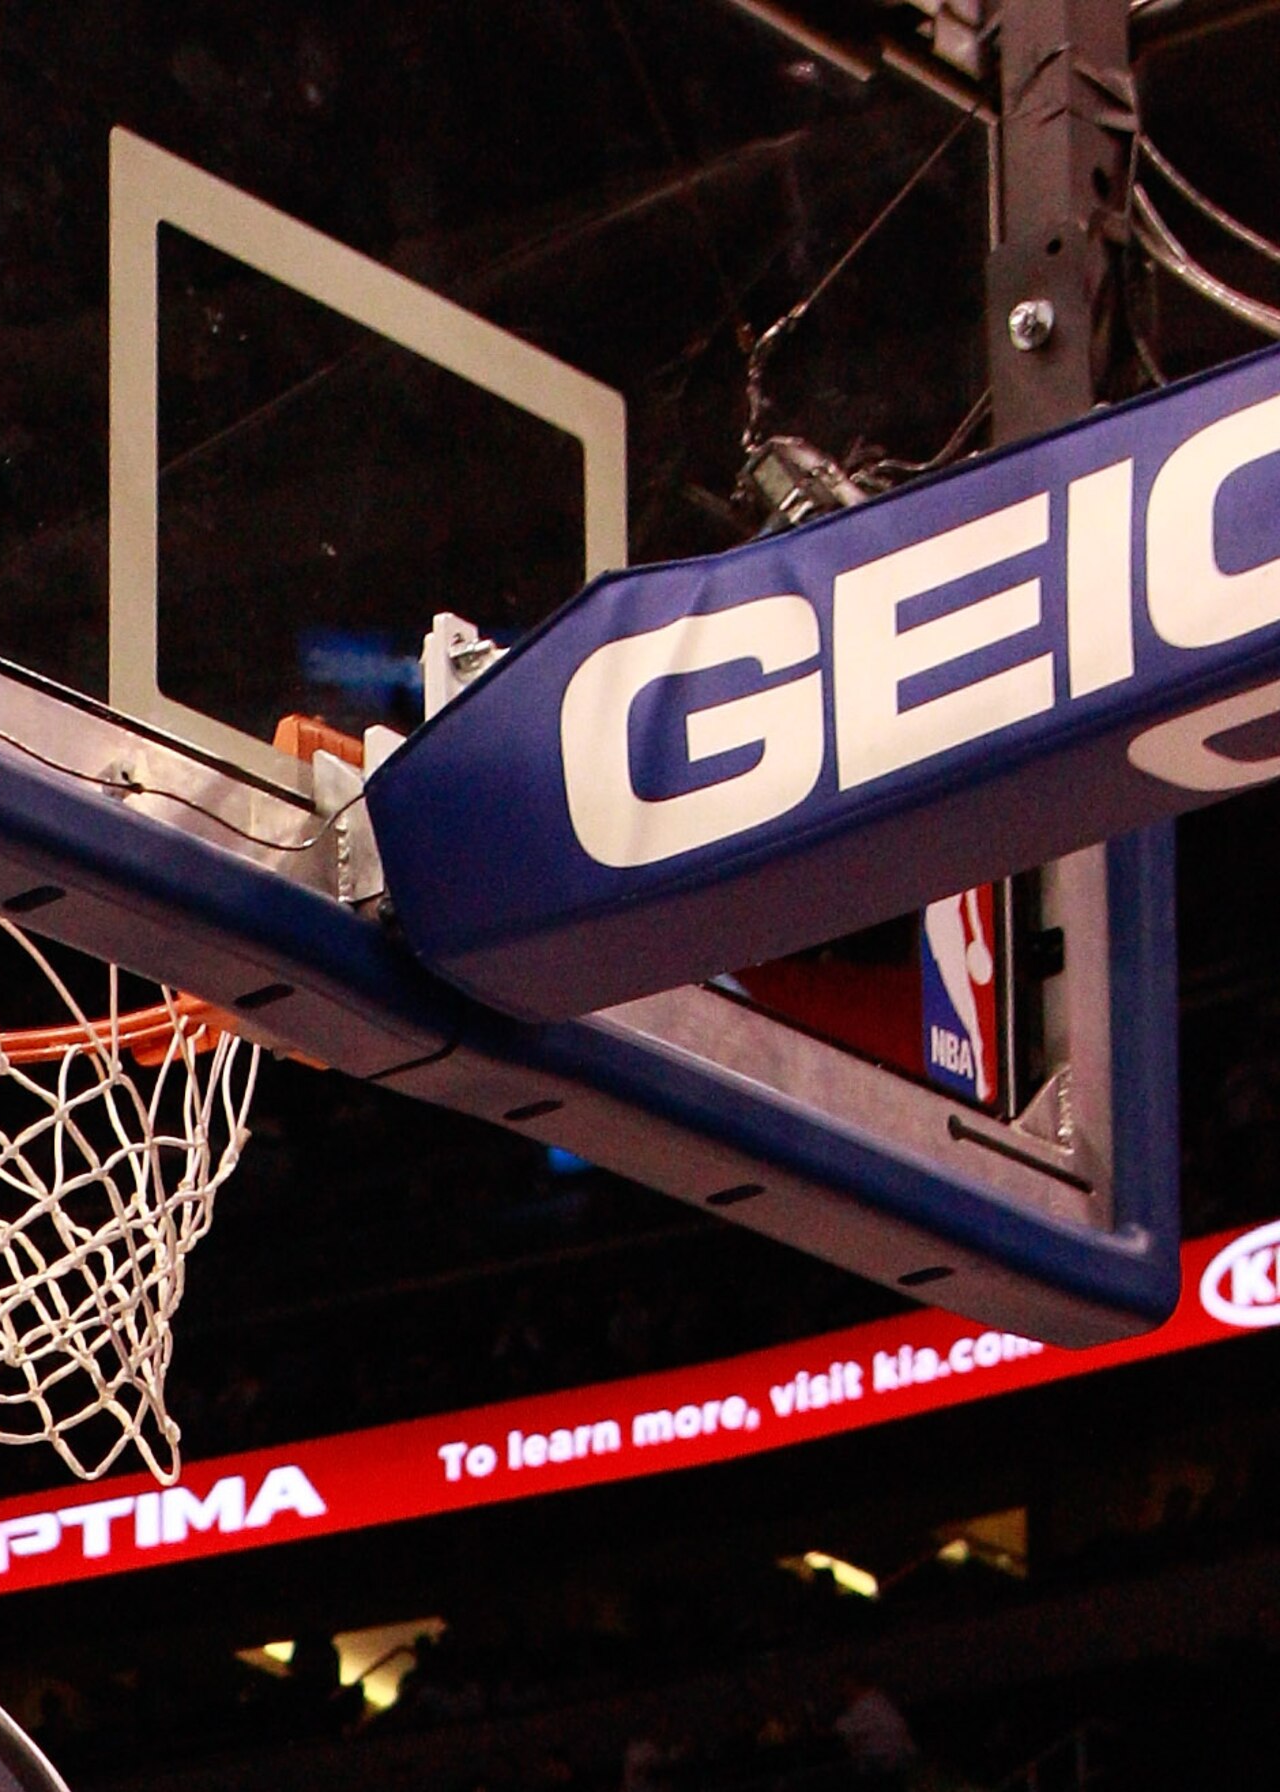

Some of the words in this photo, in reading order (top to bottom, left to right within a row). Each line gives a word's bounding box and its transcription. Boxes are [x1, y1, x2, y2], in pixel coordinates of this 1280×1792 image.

[930, 1024, 975, 1079] NBA
[438, 1442, 497, 1481] To
[507, 1420, 621, 1470] learn
[632, 1395, 760, 1447] more,
[769, 1361, 863, 1417] visit
